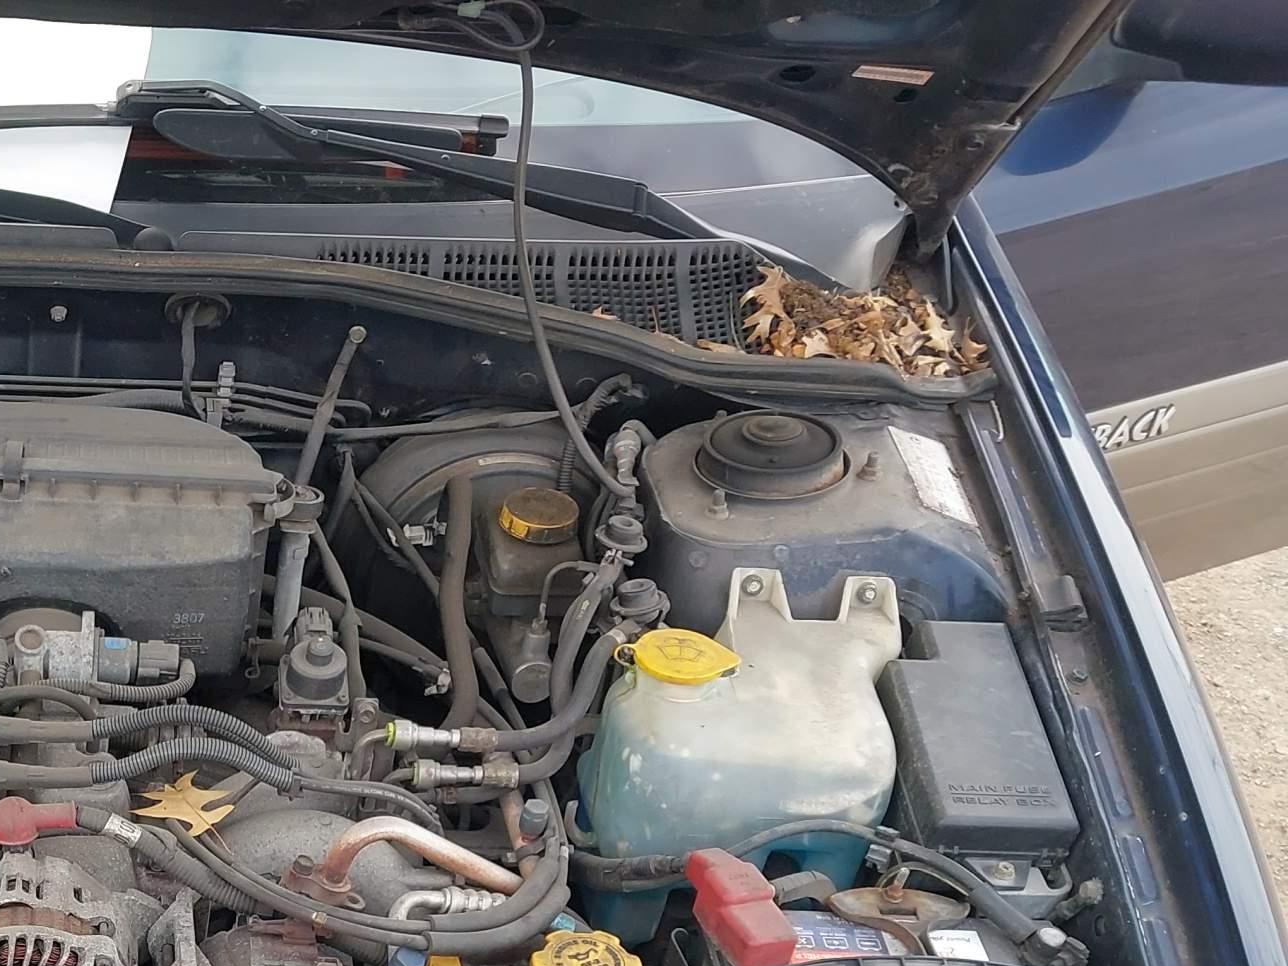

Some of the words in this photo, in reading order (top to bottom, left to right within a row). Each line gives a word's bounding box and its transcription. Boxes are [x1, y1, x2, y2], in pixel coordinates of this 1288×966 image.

[1090, 404, 1176, 449] BACK
[948, 783, 997, 793] MAIN
[951, 796, 1008, 806] RELAY
